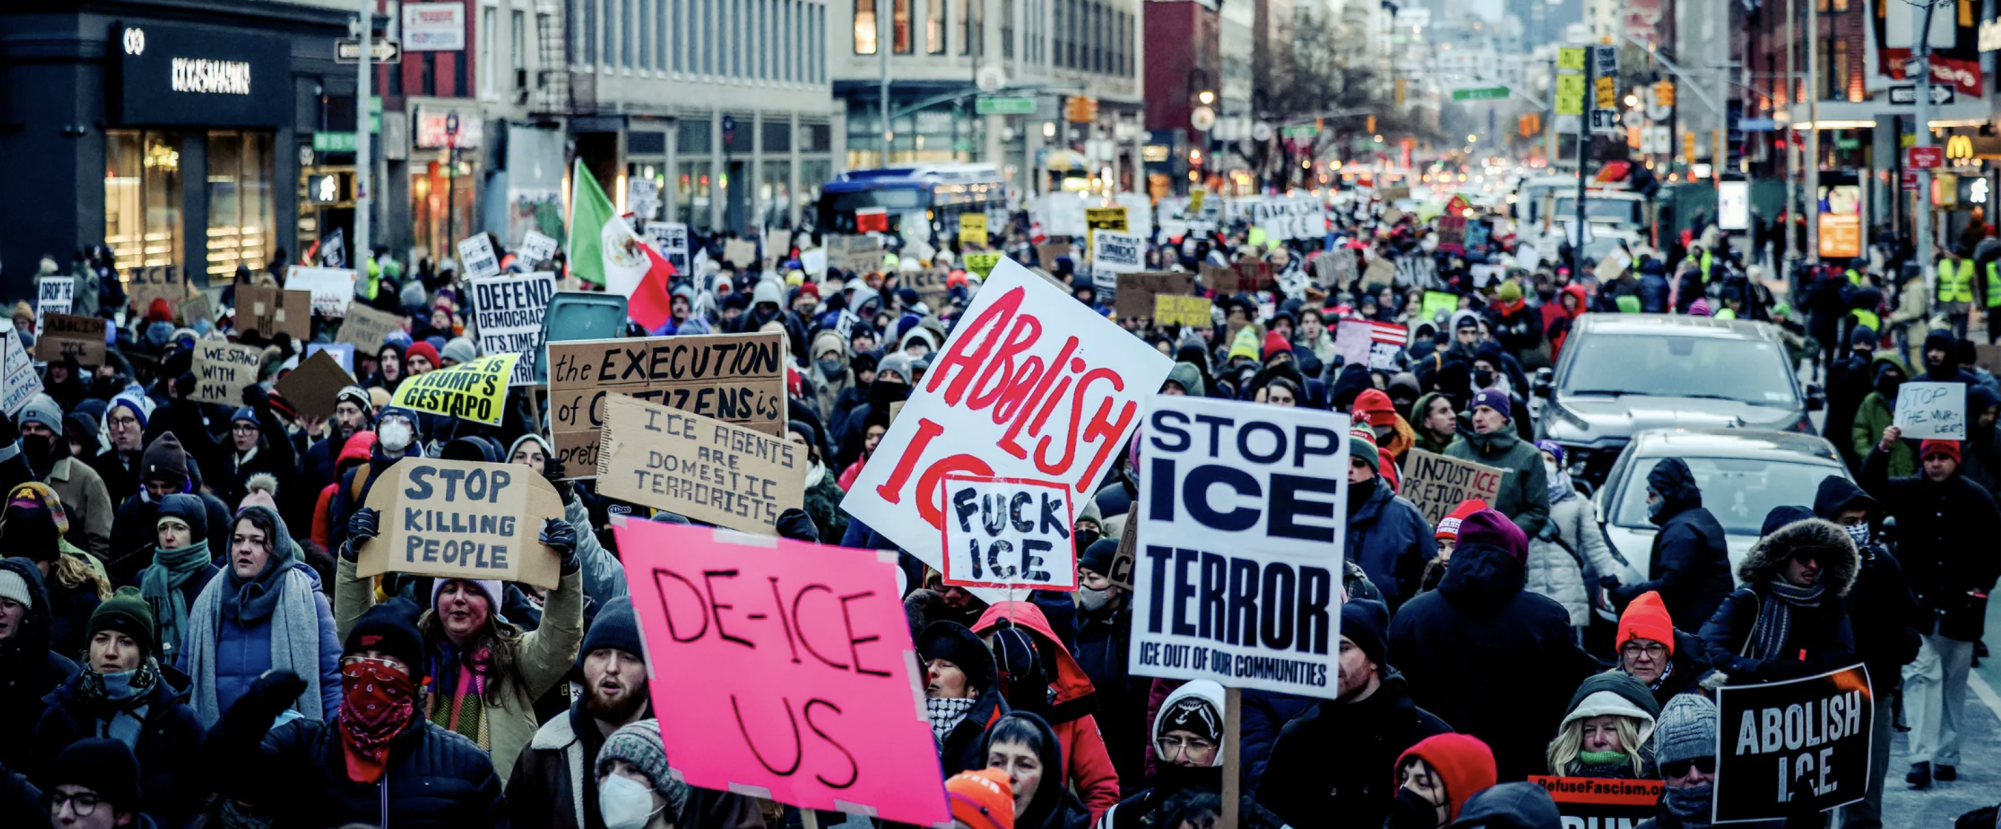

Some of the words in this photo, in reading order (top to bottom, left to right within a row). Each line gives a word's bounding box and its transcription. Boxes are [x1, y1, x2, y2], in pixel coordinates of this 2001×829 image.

[41, 282, 61, 301] DROP
[131, 267, 178, 285] ICE
[477, 279, 552, 310] DEFEND
[59, 342, 87, 357] ICE
[204, 347, 226, 362] WE
[228, 348, 259, 367] STAND
[484, 334, 507, 353] IT'S
[507, 332, 535, 353] TIME
[201, 364, 236, 382] WITH
[556, 354, 592, 383] the
[598, 341, 779, 382] EXECUTION
[202, 384, 227, 399] MN
[413, 372, 499, 396] TRUMP'S
[1900, 386, 1948, 411] STOP
[403, 387, 492, 420] GESTAPO
[559, 398, 583, 426] of
[756, 390, 778, 420] is
[1901, 410, 1928, 426] THE
[644, 408, 698, 440] ICE
[714, 425, 794, 469] AGENTS
[1149, 408, 1340, 468] STOP
[646, 450, 777, 501] DOMESTIC
[698, 445, 740, 471] ARE
[1414, 456, 1500, 494] INJUSTICE
[404, 465, 511, 503] STOP
[634, 470, 777, 527] TERRORISTS
[1149, 456, 1338, 544] ICE
[404, 506, 516, 537] KILLING
[953, 486, 1071, 540] FUCK
[406, 534, 509, 569] PEOPLE
[969, 538, 1053, 582] ICE
[1145, 544, 1331, 656] TERROR
[651, 568, 893, 678] DE-ICE
[1139, 641, 1160, 667] ICE
[1163, 643, 1191, 669] OUT
[1193, 646, 1209, 671] OF
[1211, 649, 1233, 677] OUR
[1235, 654, 1328, 688] COMMUNITIES
[1735, 690, 1861, 756] ABOLISH
[730, 693, 859, 790] US
